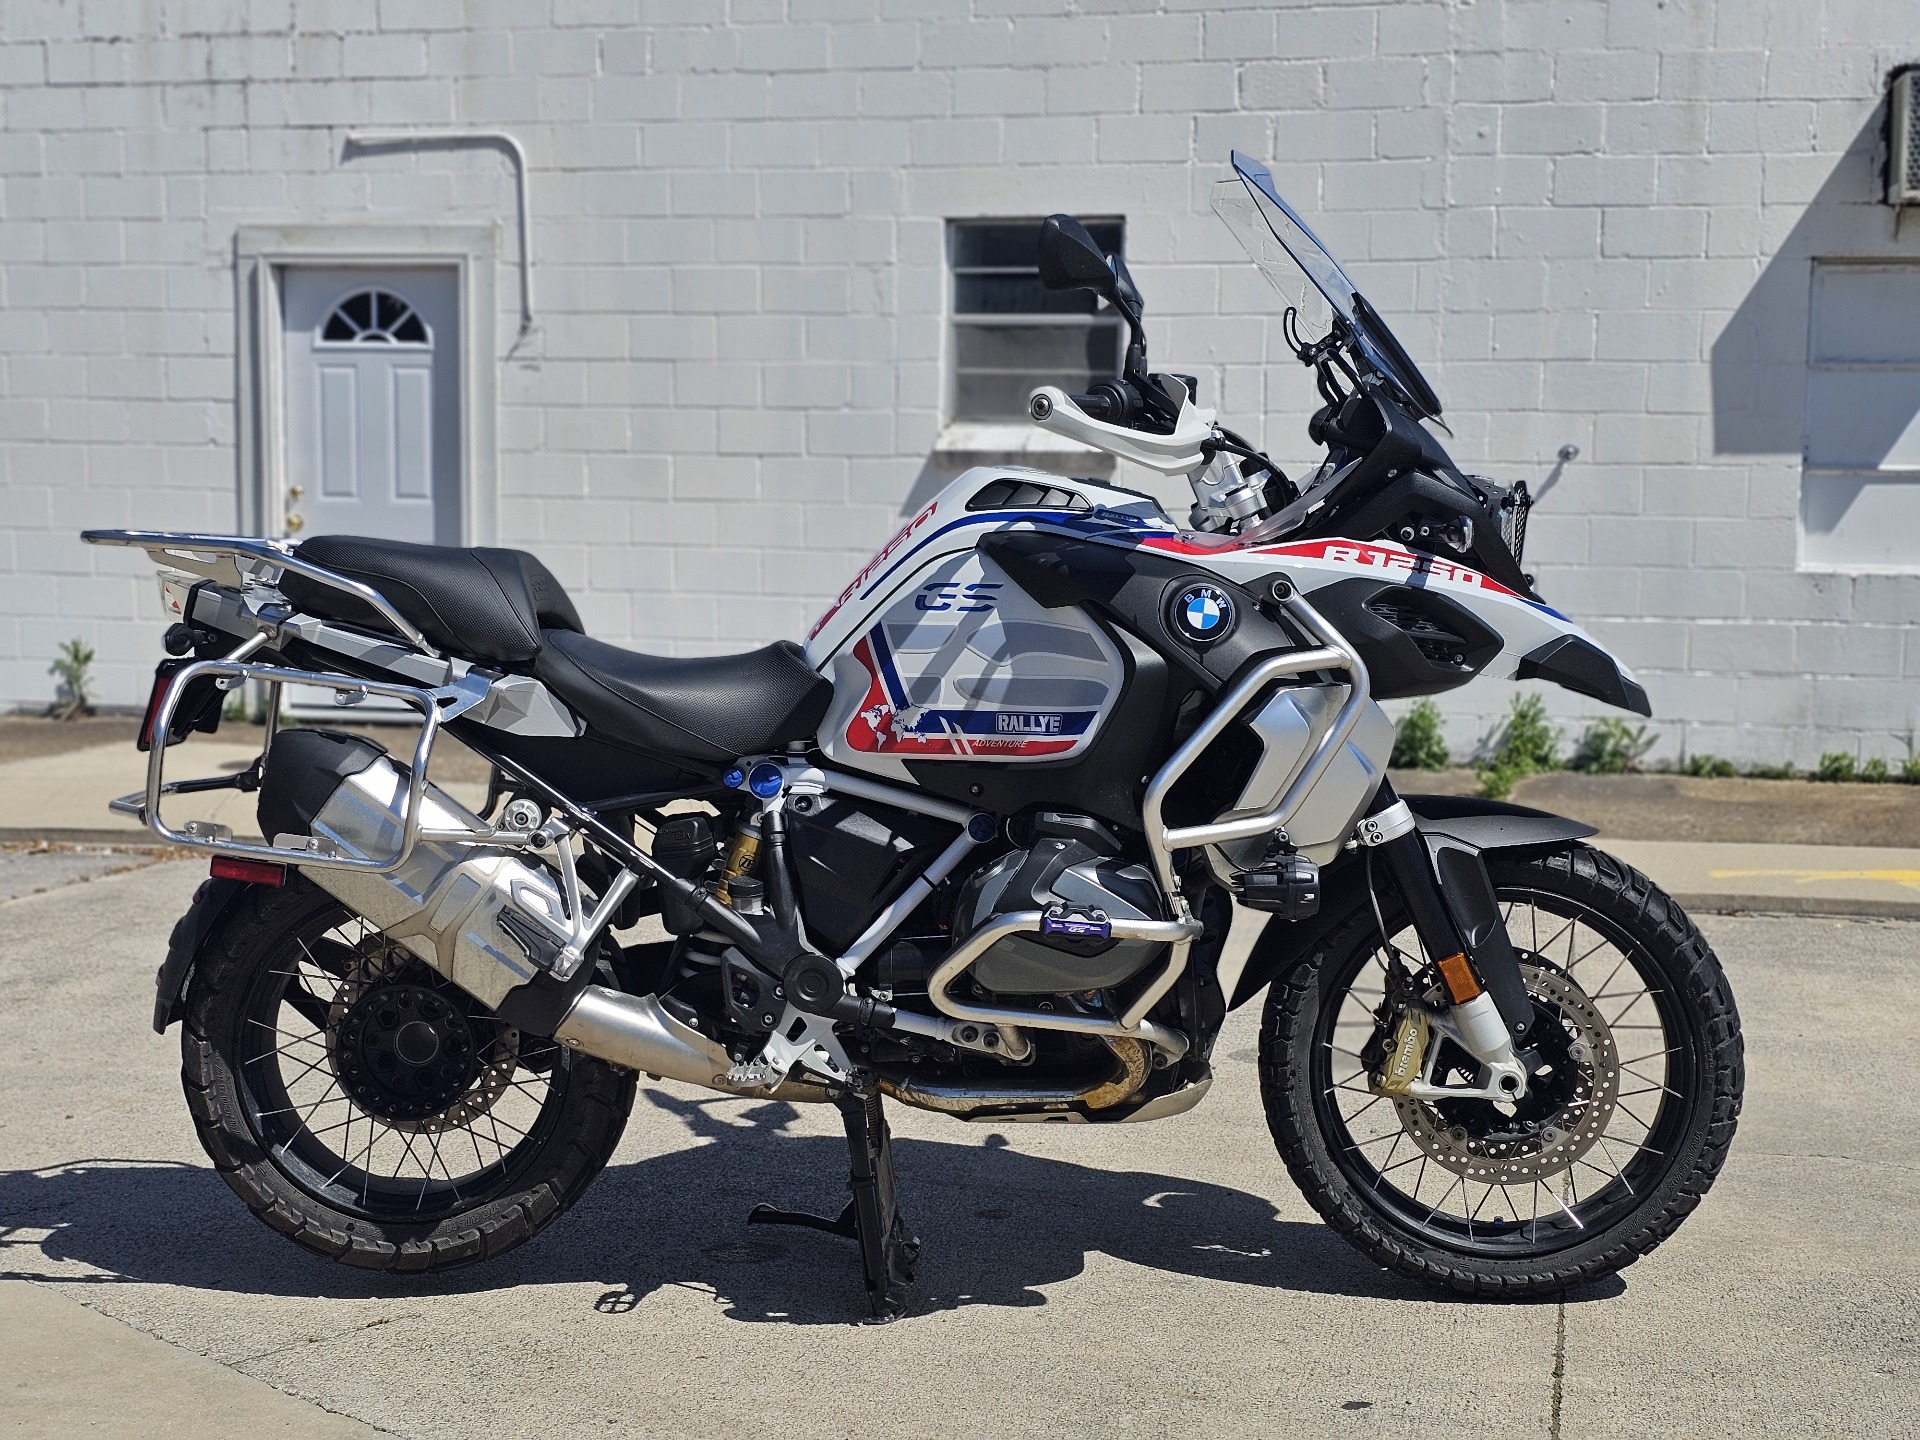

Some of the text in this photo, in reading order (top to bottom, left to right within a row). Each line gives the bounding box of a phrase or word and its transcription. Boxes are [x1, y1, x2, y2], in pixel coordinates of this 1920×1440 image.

[915, 582, 1004, 612] GS
[1184, 589, 1227, 609] BMW
[997, 714, 1061, 733] RALLYE
[971, 739, 1029, 749] ADVENTURE
[1394, 1028, 1418, 1077] brembo
